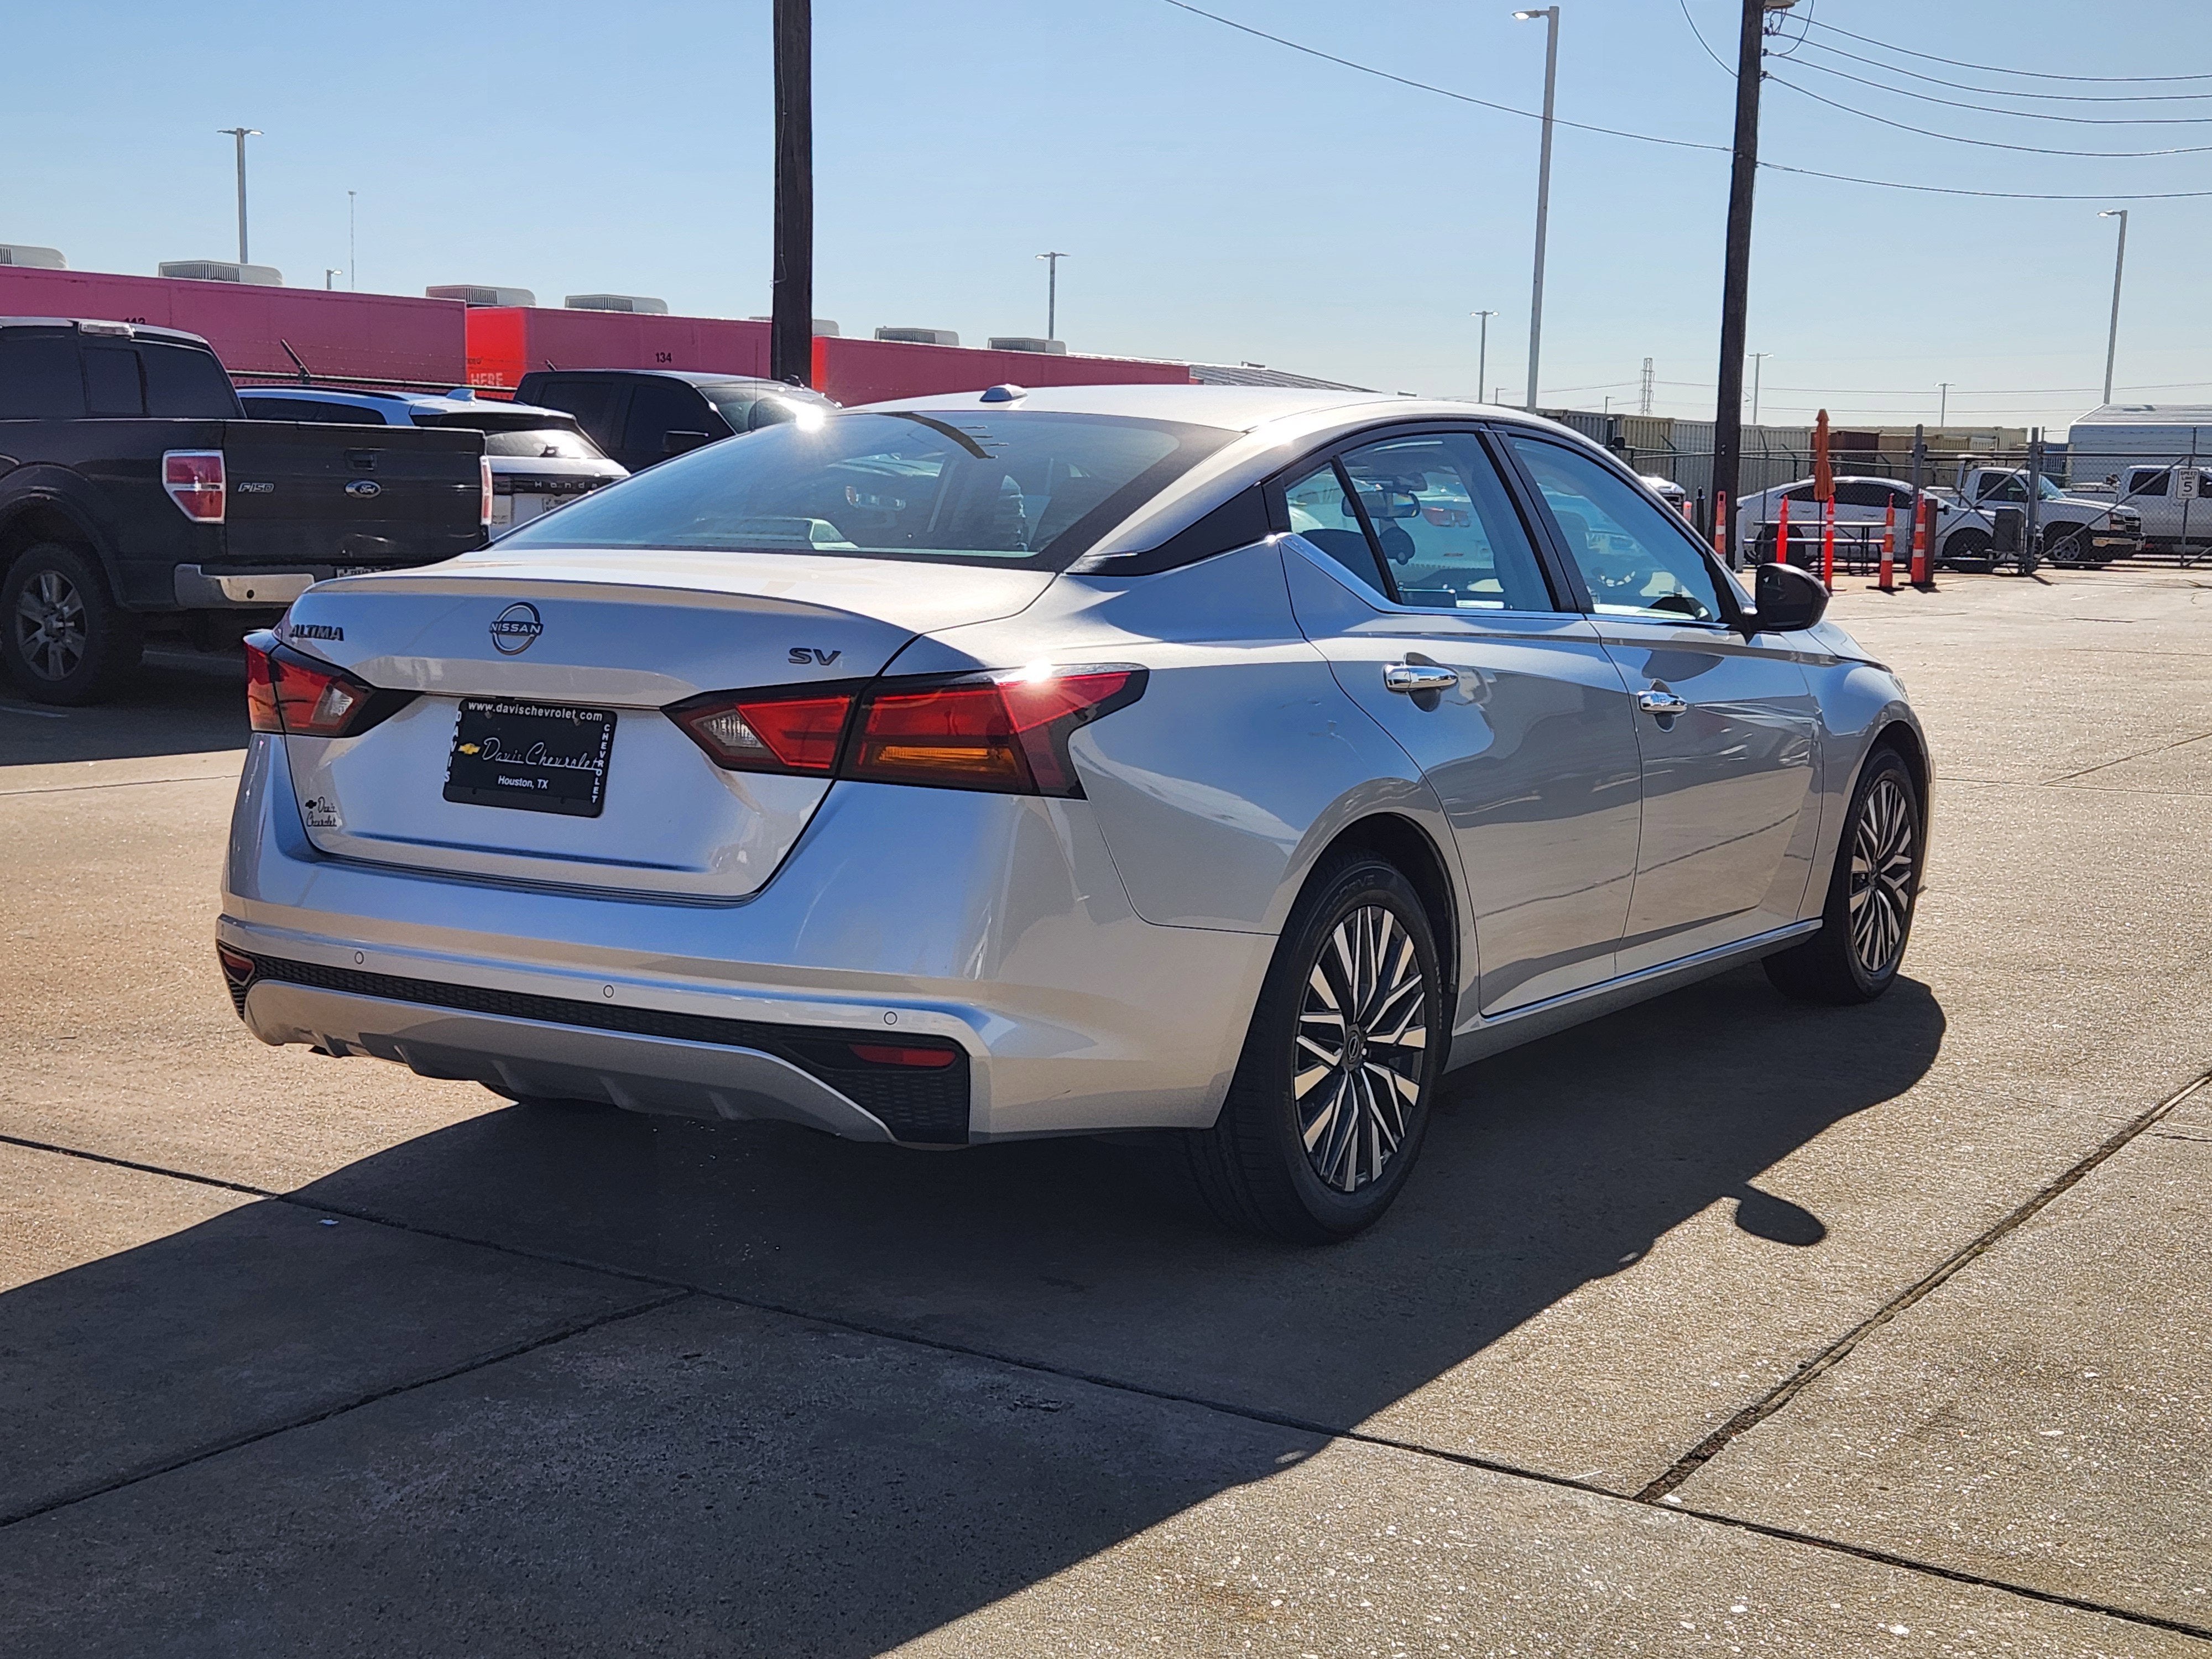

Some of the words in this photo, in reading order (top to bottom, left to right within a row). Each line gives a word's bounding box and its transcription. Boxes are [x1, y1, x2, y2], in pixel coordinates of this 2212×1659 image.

[656, 352, 672, 363] 134
[471, 372, 504, 385] HERE
[2183, 481, 2193, 492] 5
[289, 624, 344, 641] ALTIMA
[491, 623, 541, 634] NISSAN
[788, 648, 842, 666] SV
[468, 702, 603, 722] www.davischevroletcom
[445, 711, 462, 782] DAVIS
[482, 737, 524, 764] Davis
[525, 742, 599, 771] Chevrolet
[592, 724, 611, 804] CHEVROLET
[498, 775, 534, 790] Houston,
[537, 779, 549, 789] TX
